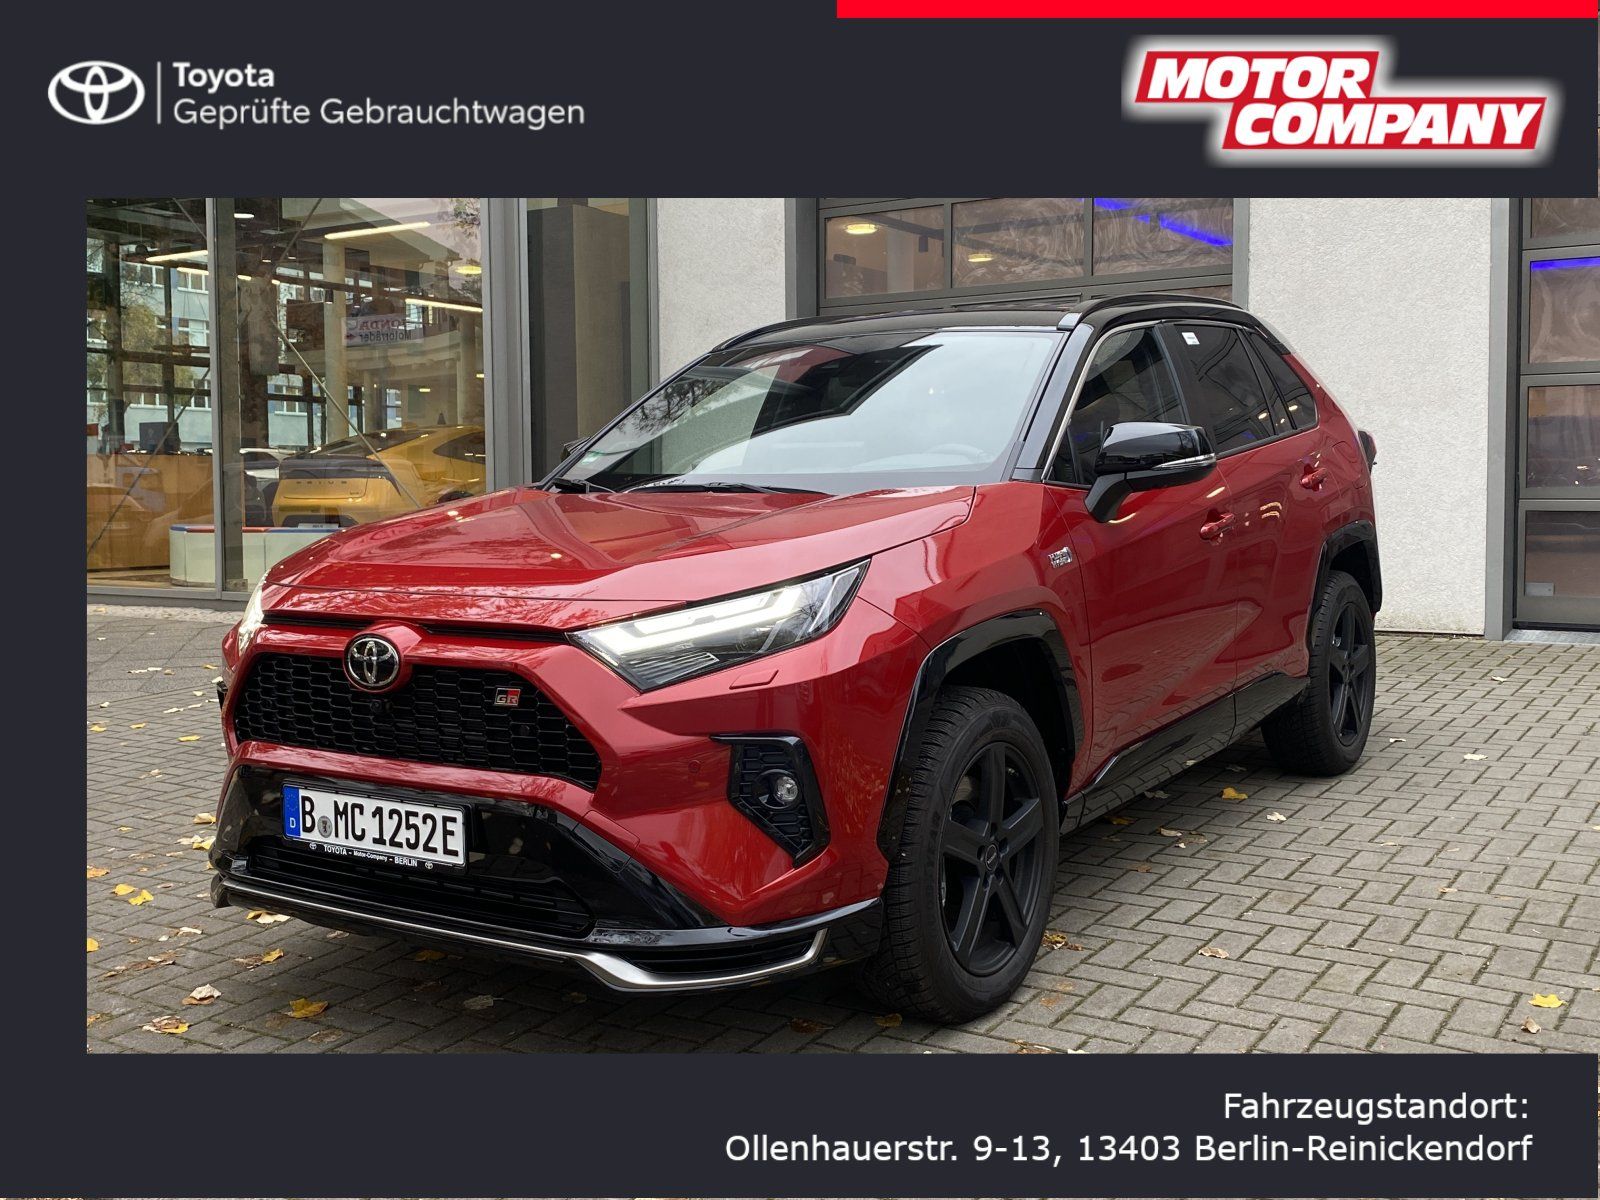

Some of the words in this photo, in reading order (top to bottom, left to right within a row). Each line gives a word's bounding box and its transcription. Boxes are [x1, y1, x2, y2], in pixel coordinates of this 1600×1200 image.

[289, 817, 296, 828] D
[301, 795, 316, 833] B
[324, 844, 348, 856] TOYOTA
[353, 849, 388, 862] Motor-Company
[394, 856, 418, 867] BERLIN
